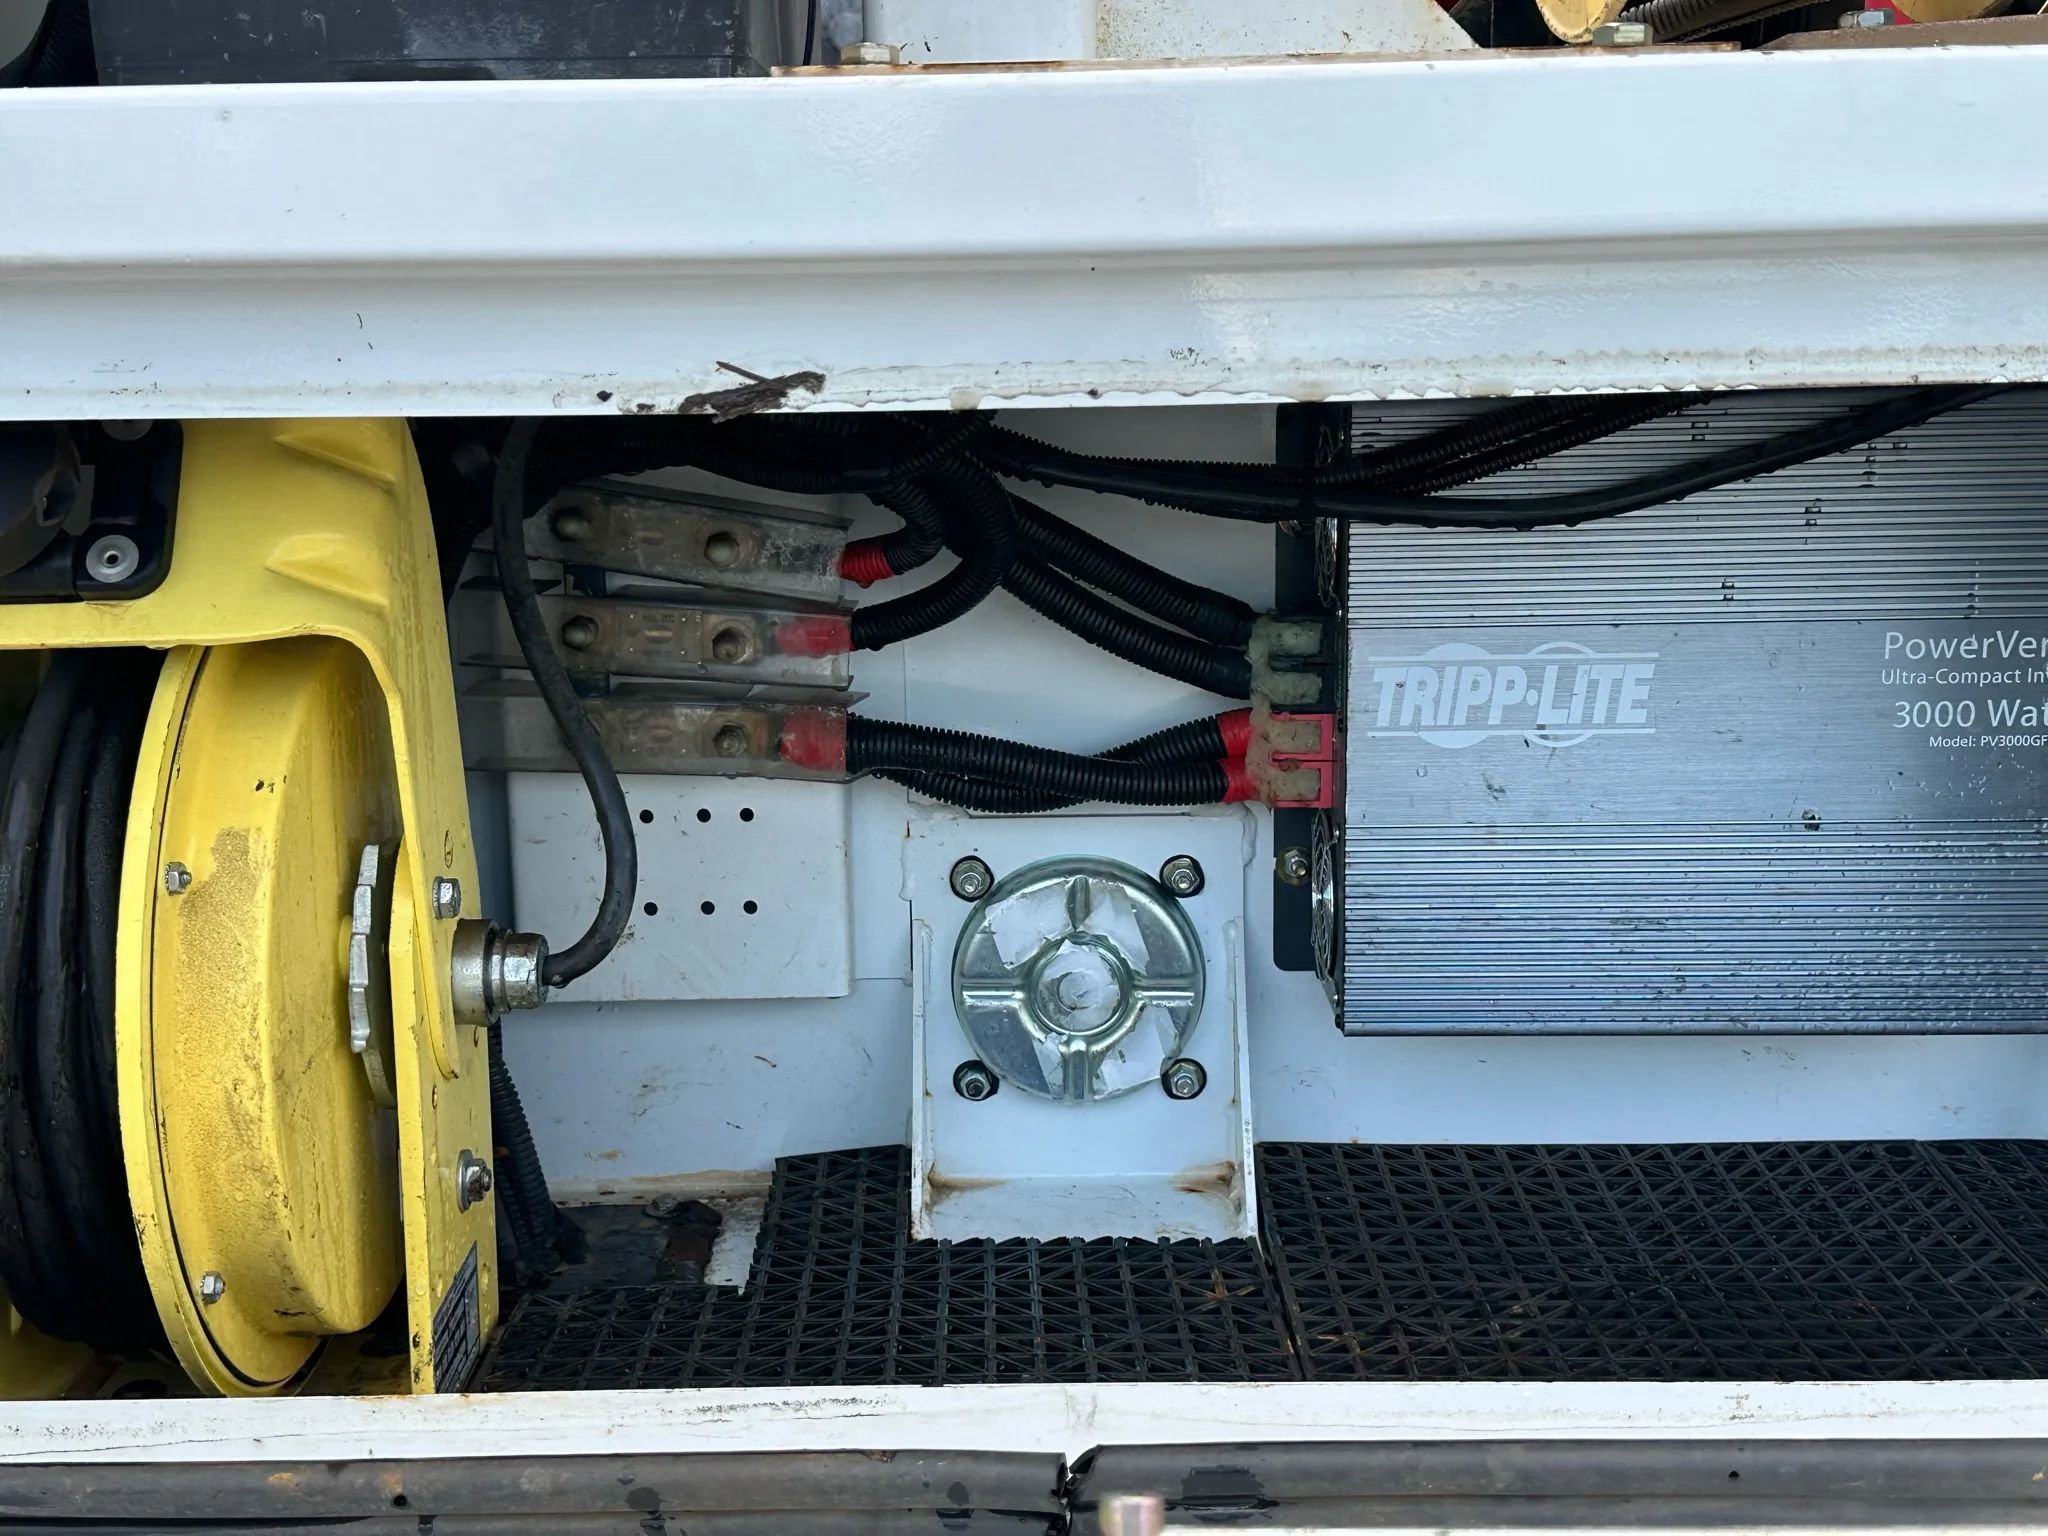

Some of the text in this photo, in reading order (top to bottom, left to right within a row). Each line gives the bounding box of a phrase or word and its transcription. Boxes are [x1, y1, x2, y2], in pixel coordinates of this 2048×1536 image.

[1882, 667, 2048, 687] Ultra-Compact In
[1893, 700, 1976, 728] 3000
[1929, 735, 2048, 748] Model: PV3000GF
